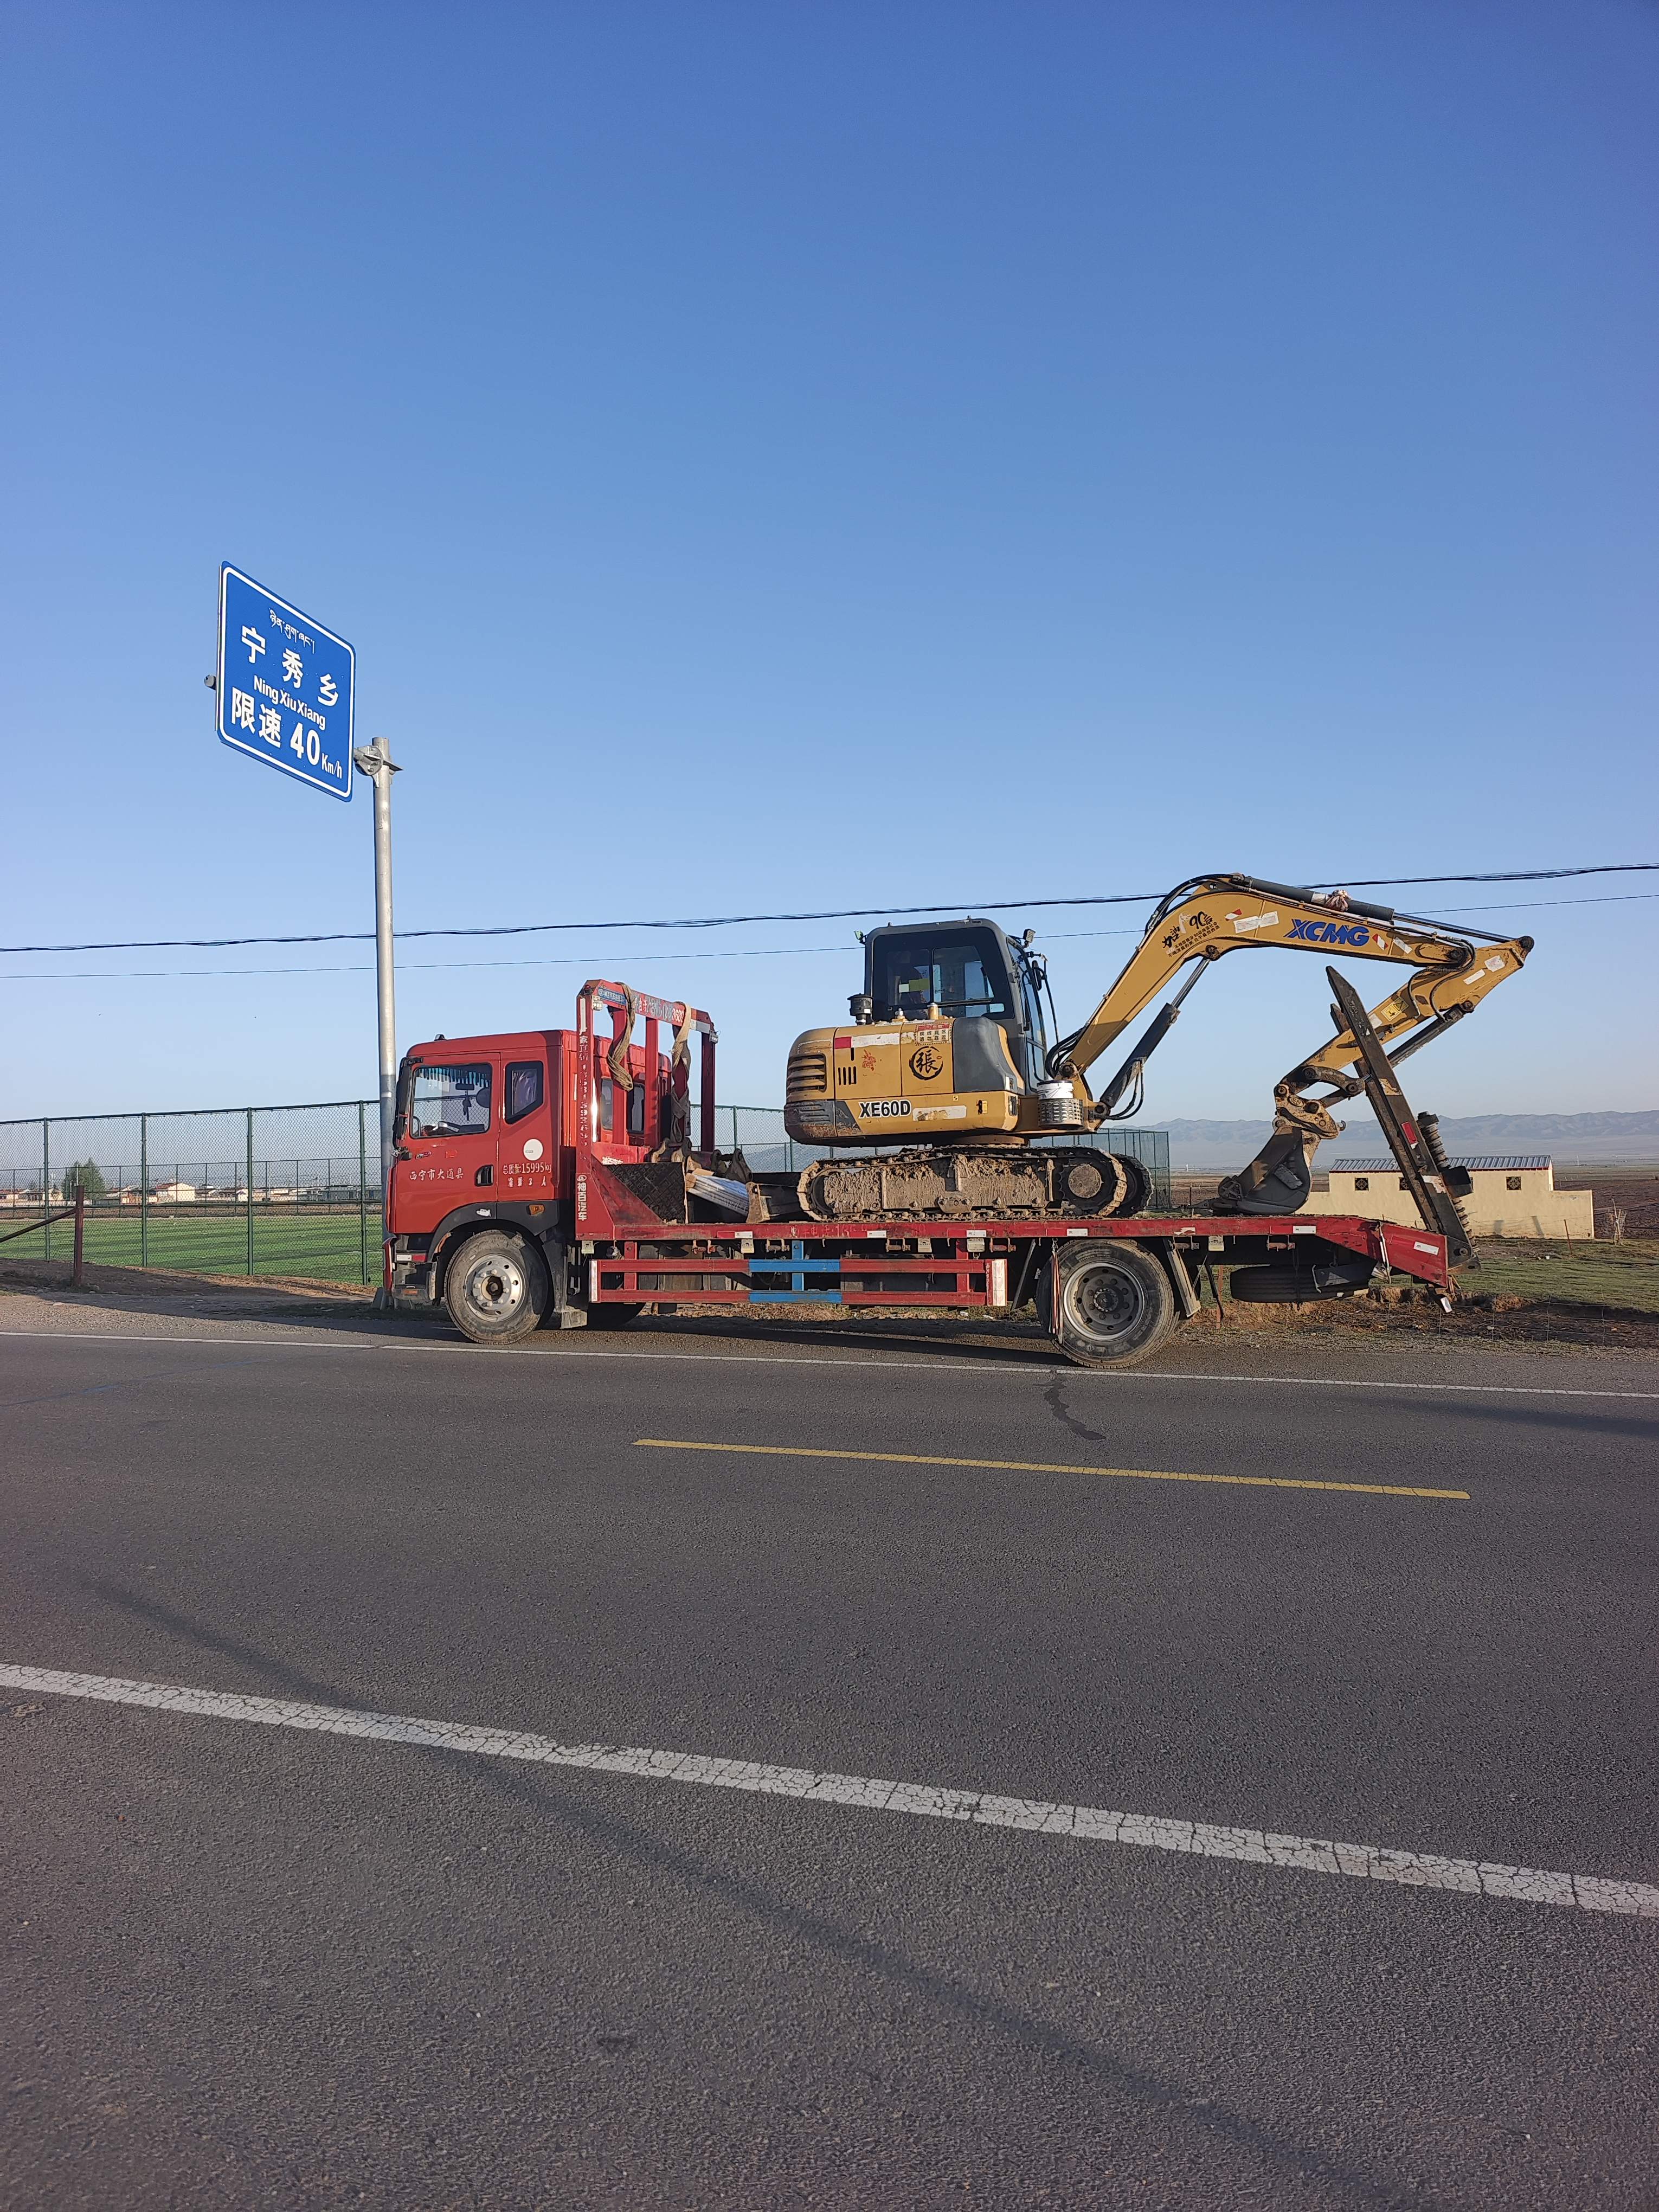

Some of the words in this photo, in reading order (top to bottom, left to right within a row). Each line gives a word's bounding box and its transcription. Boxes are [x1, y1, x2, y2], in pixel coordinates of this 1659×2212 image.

[241, 625, 339, 706] 宁秀乡
[231, 686, 281, 748] 限速
[1283, 918, 1371, 947] XCMG
[859, 1100, 912, 1118] XE60D
